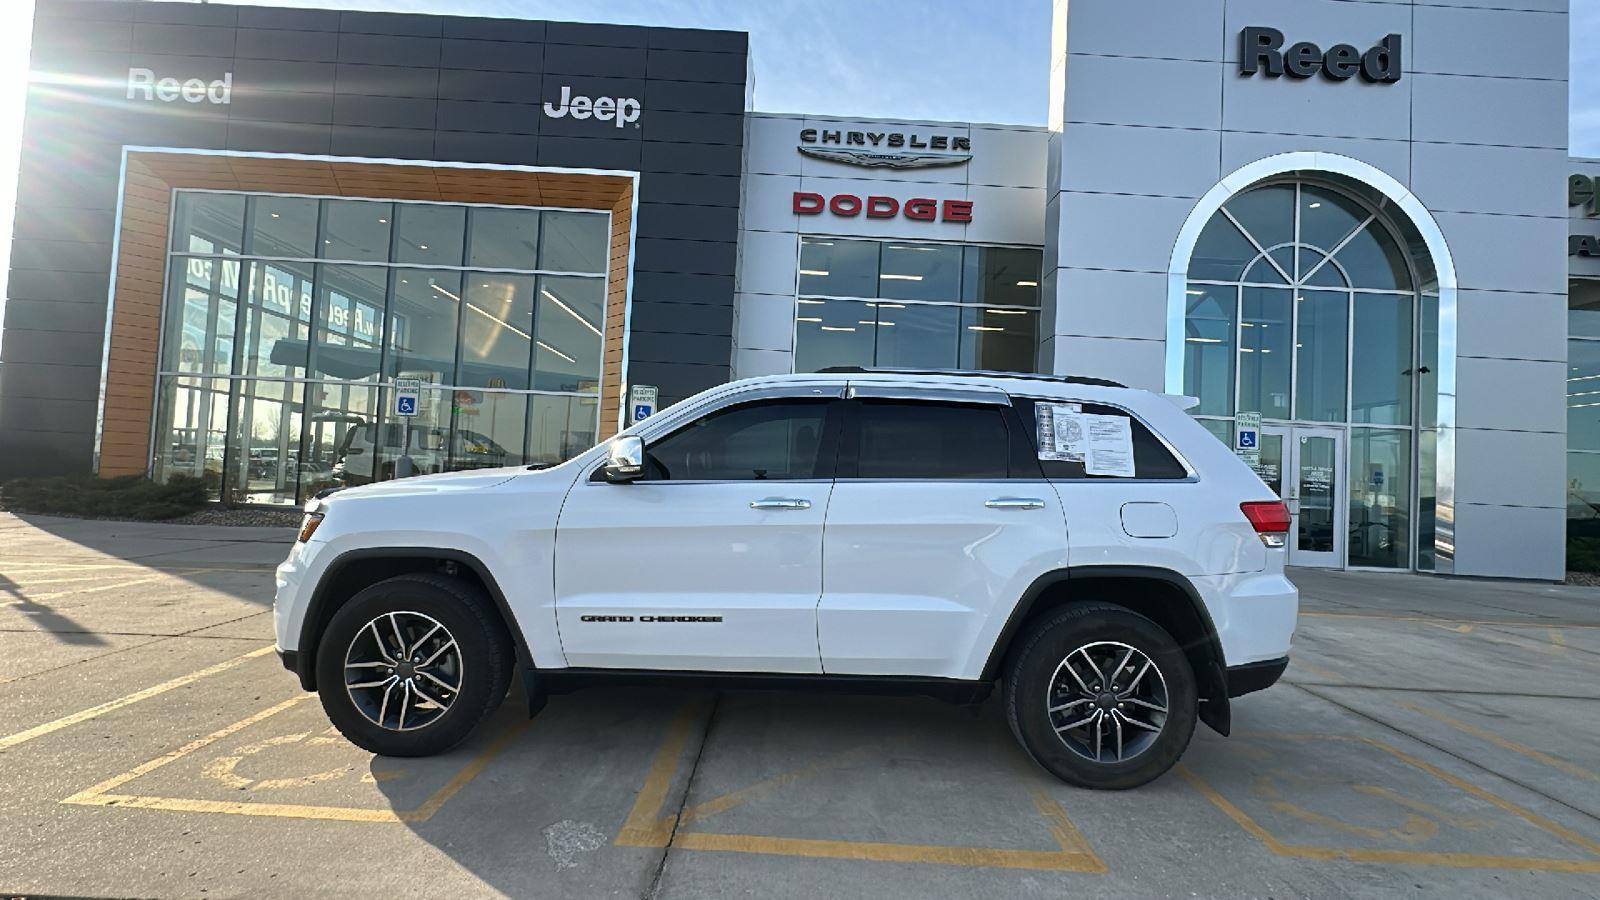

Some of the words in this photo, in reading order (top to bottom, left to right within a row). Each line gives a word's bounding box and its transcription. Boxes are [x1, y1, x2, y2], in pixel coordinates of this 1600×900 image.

[1239, 26, 1402, 84] Reed
[126, 67, 233, 104] Reed
[543, 86, 641, 129] Jeep
[799, 128, 972, 151] CHRYSLER
[792, 191, 974, 223] DODGE
[580, 615, 635, 623] GRAND
[639, 615, 723, 623] CHEROKEE
